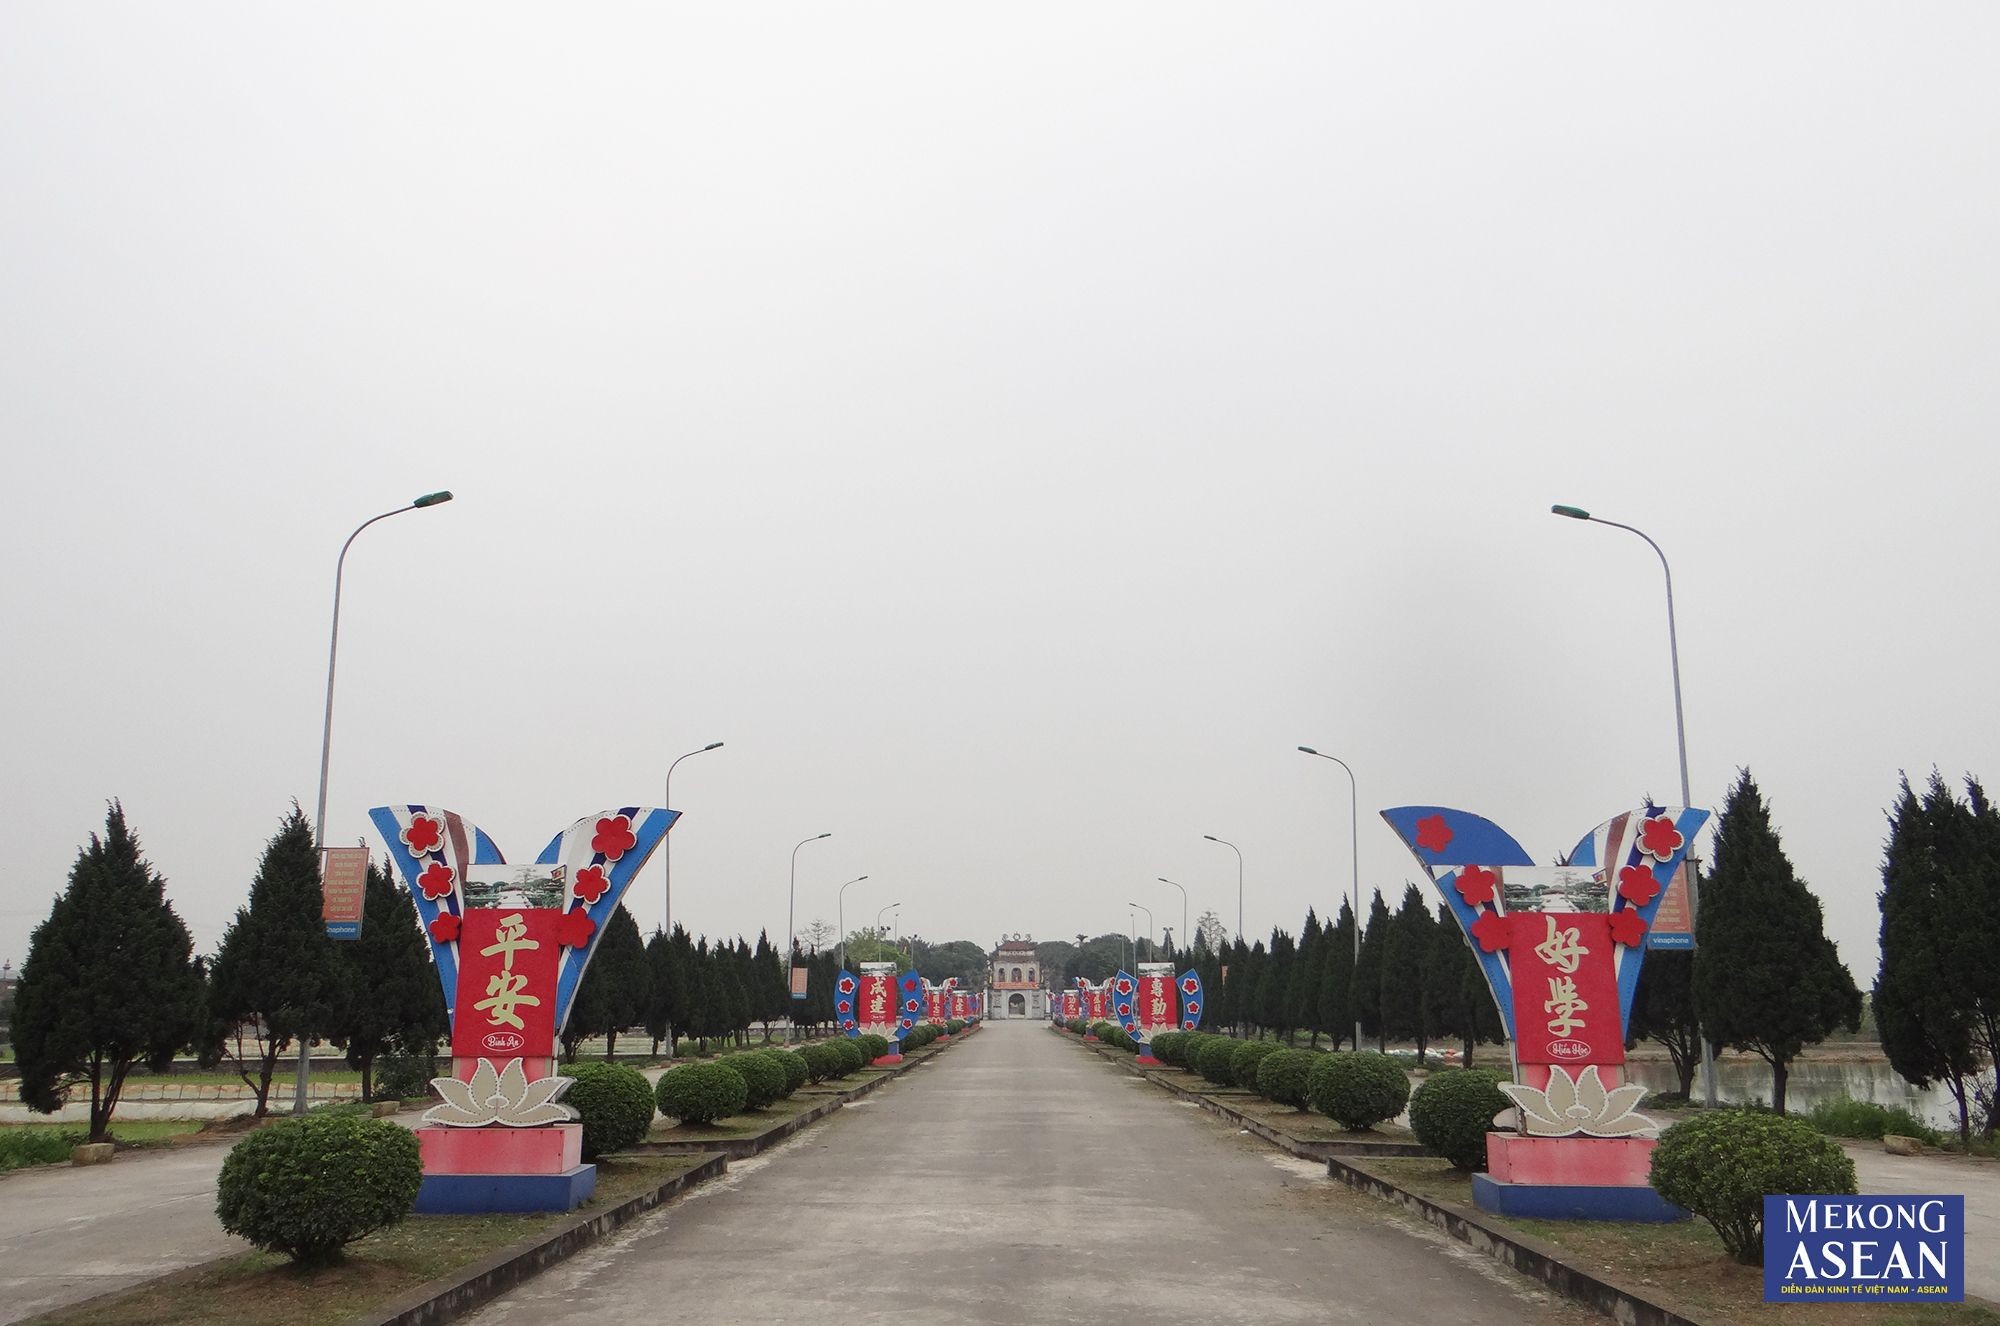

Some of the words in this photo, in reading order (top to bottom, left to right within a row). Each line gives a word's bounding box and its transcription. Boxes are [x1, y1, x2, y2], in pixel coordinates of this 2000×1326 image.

[1652, 936, 1689, 945] vinaphone
[473, 912, 540, 1031] 平安
[507, 1035, 519, 1047] An
